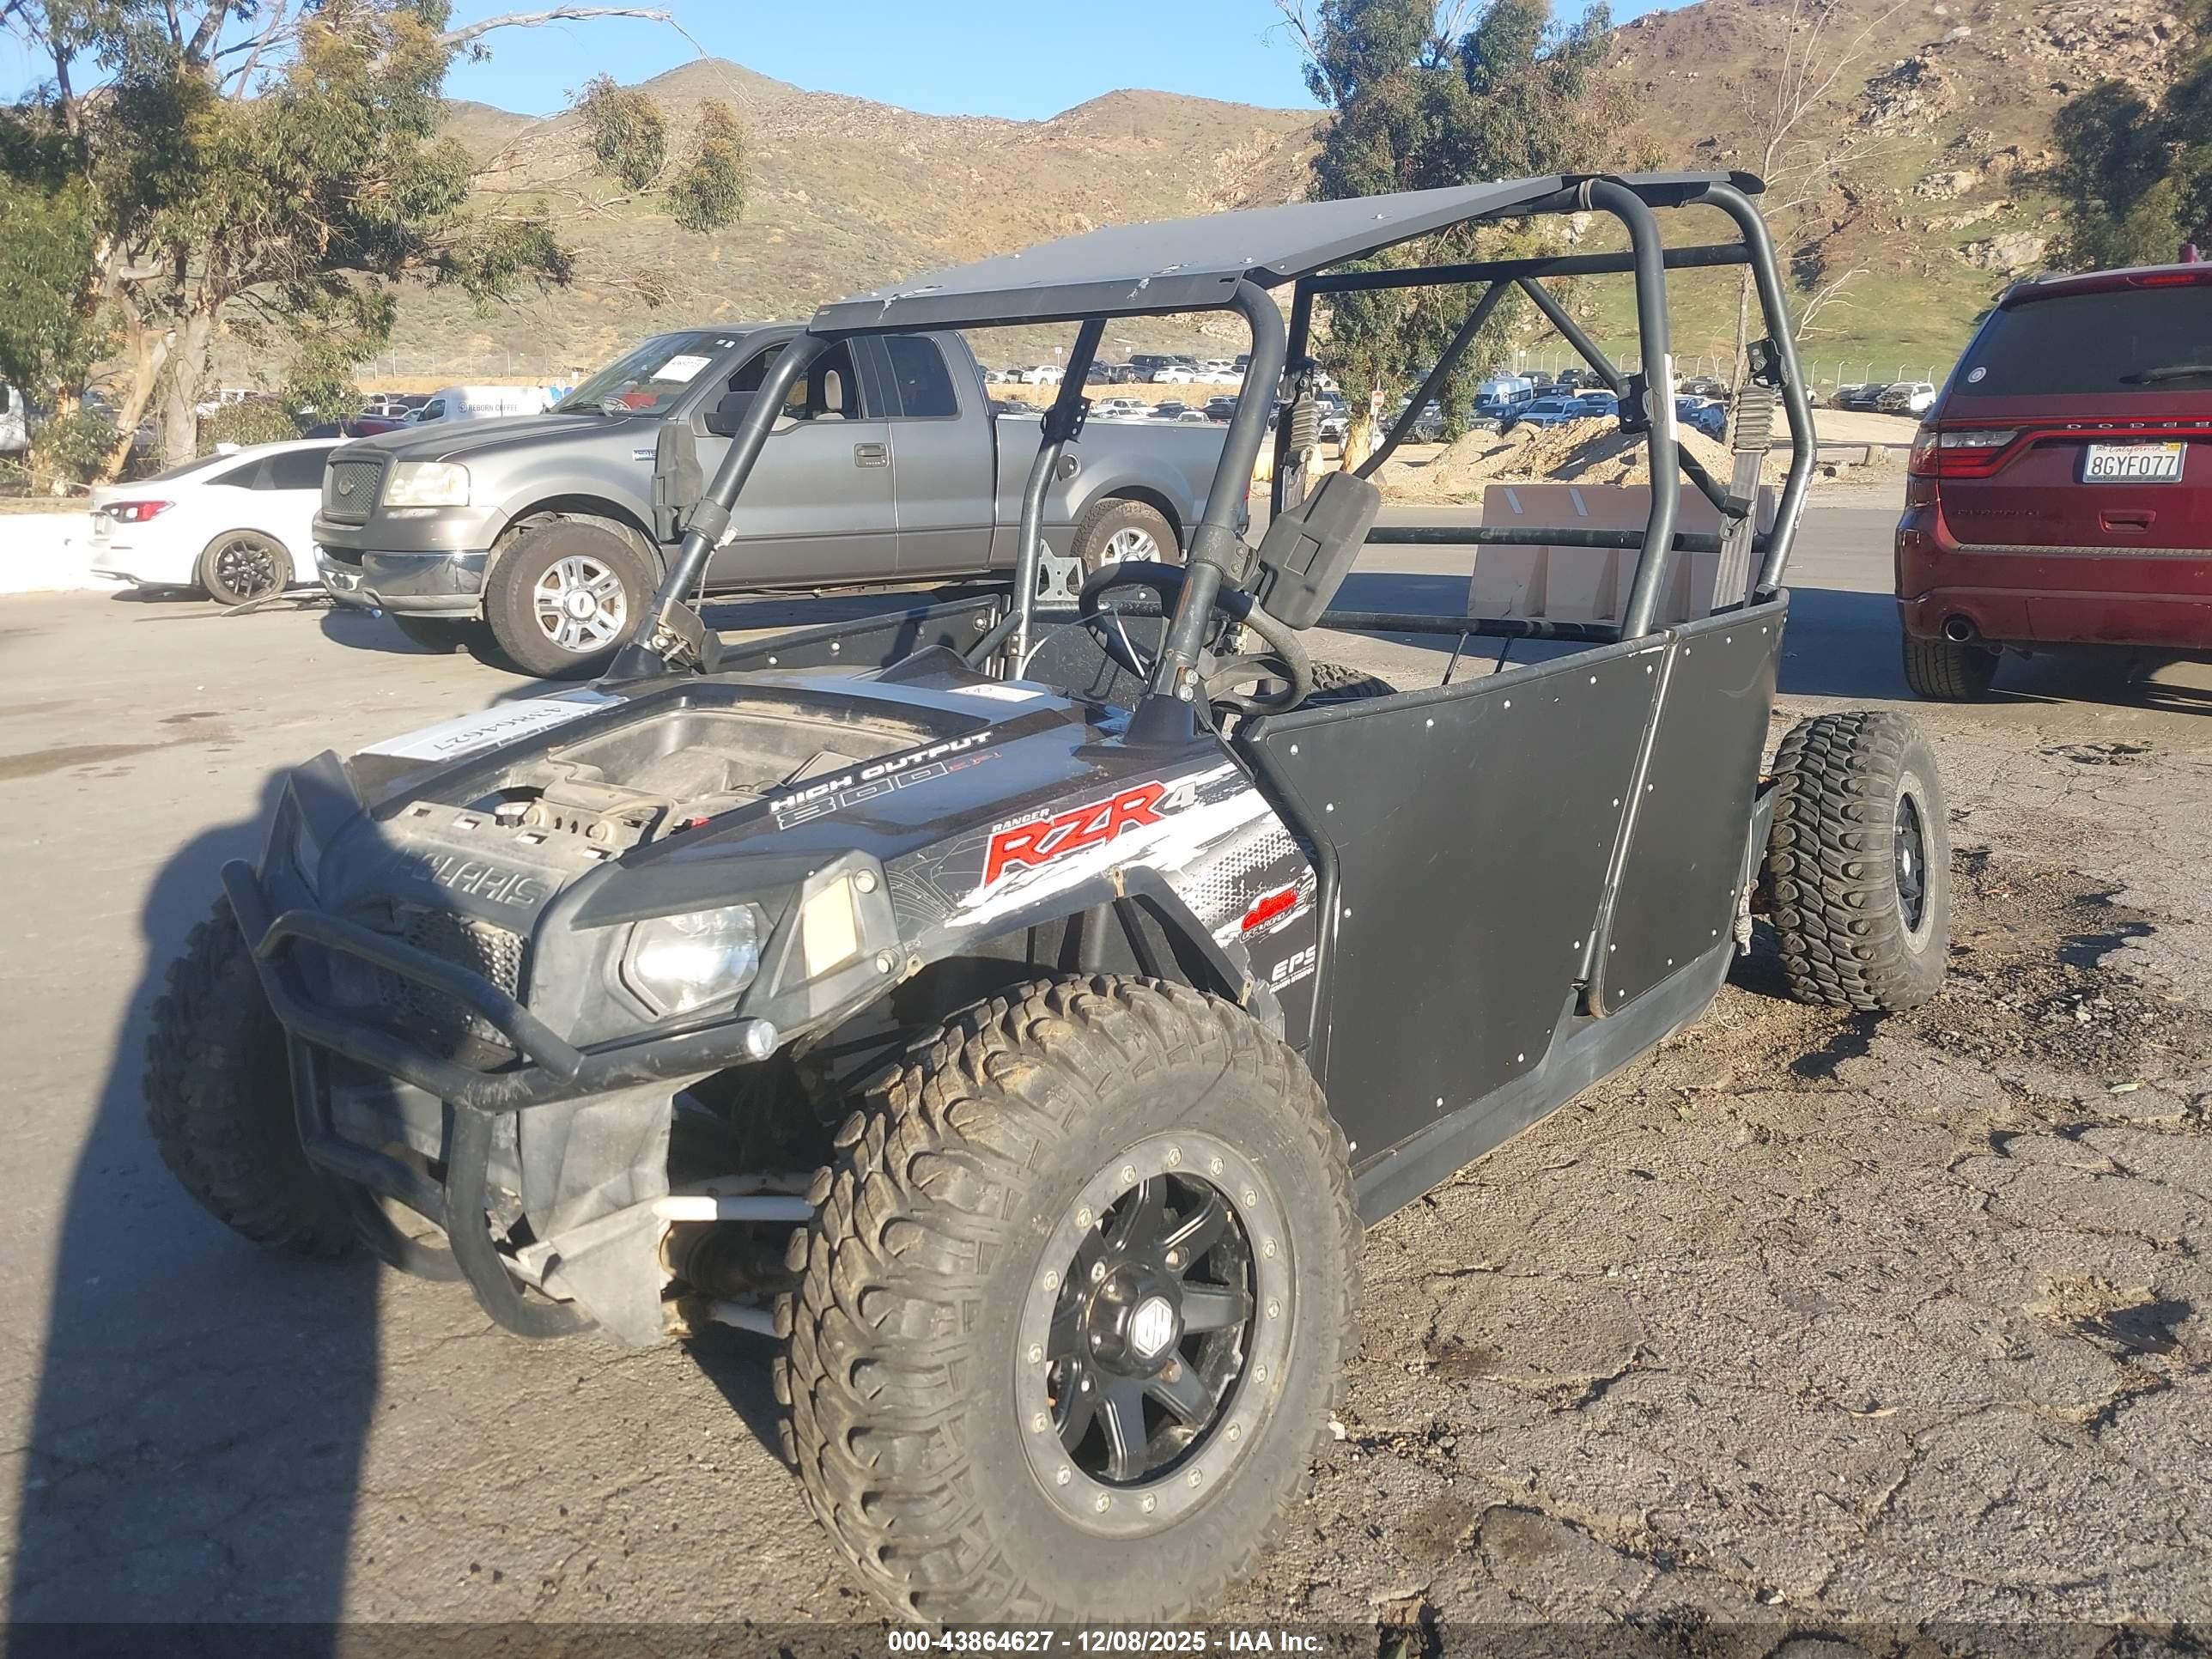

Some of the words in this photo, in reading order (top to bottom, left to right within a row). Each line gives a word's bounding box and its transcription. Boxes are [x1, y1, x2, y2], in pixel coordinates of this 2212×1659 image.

[468, 404, 494, 412] REBORN
[495, 404, 517, 412] COFFEE
[2067, 421, 2210, 429] DODGE
[2109, 444, 2163, 455] California
[2091, 455, 2176, 476] 8GYF077
[433, 706, 562, 750] 43864627
[769, 775, 854, 813] HIGH
[860, 731, 992, 781] OUTPUT
[775, 761, 949, 831] 800
[981, 780, 1170, 889] RZR
[1164, 781, 1199, 811] 4
[991, 808, 1051, 833] RANGER
[1271, 944, 1316, 982] EPS
